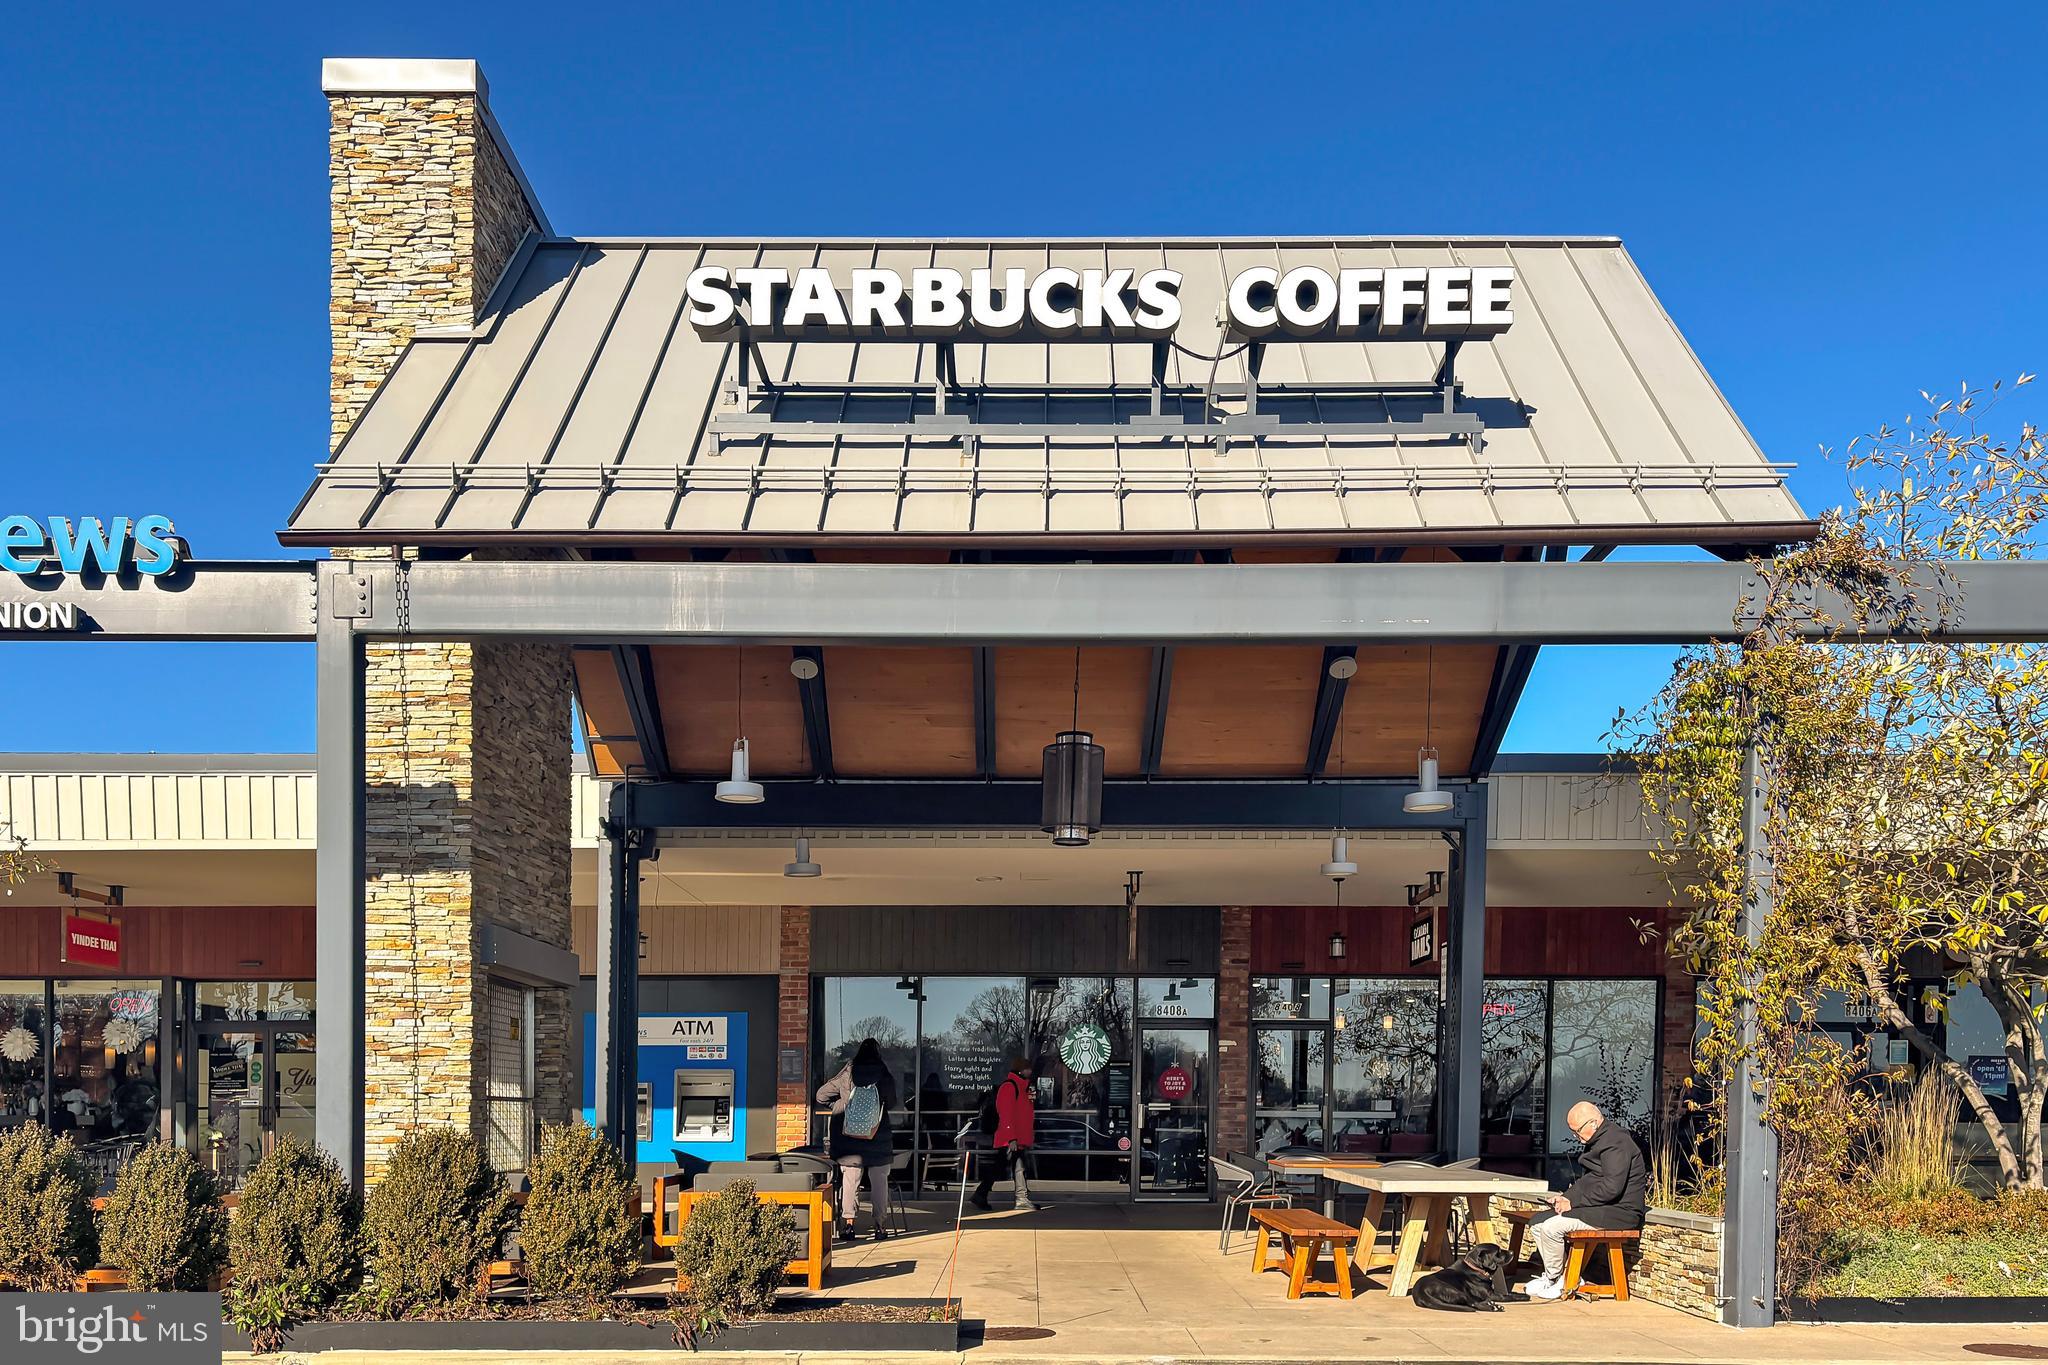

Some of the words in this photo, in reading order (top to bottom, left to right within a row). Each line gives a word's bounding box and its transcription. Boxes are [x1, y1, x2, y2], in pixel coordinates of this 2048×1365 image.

[686, 266, 1182, 330] STARBUCKS
[1228, 266, 1514, 329] COFFEE
[71, 933, 99, 948] YINDEE
[99, 939, 117, 952] THAI
[109, 998, 151, 1012] OPEN
[1156, 1005, 1188, 1016] 8408A
[1482, 1003, 1516, 1017] PEN
[672, 1020, 714, 1035] ATM
[944, 1065, 962, 1073] Starry
